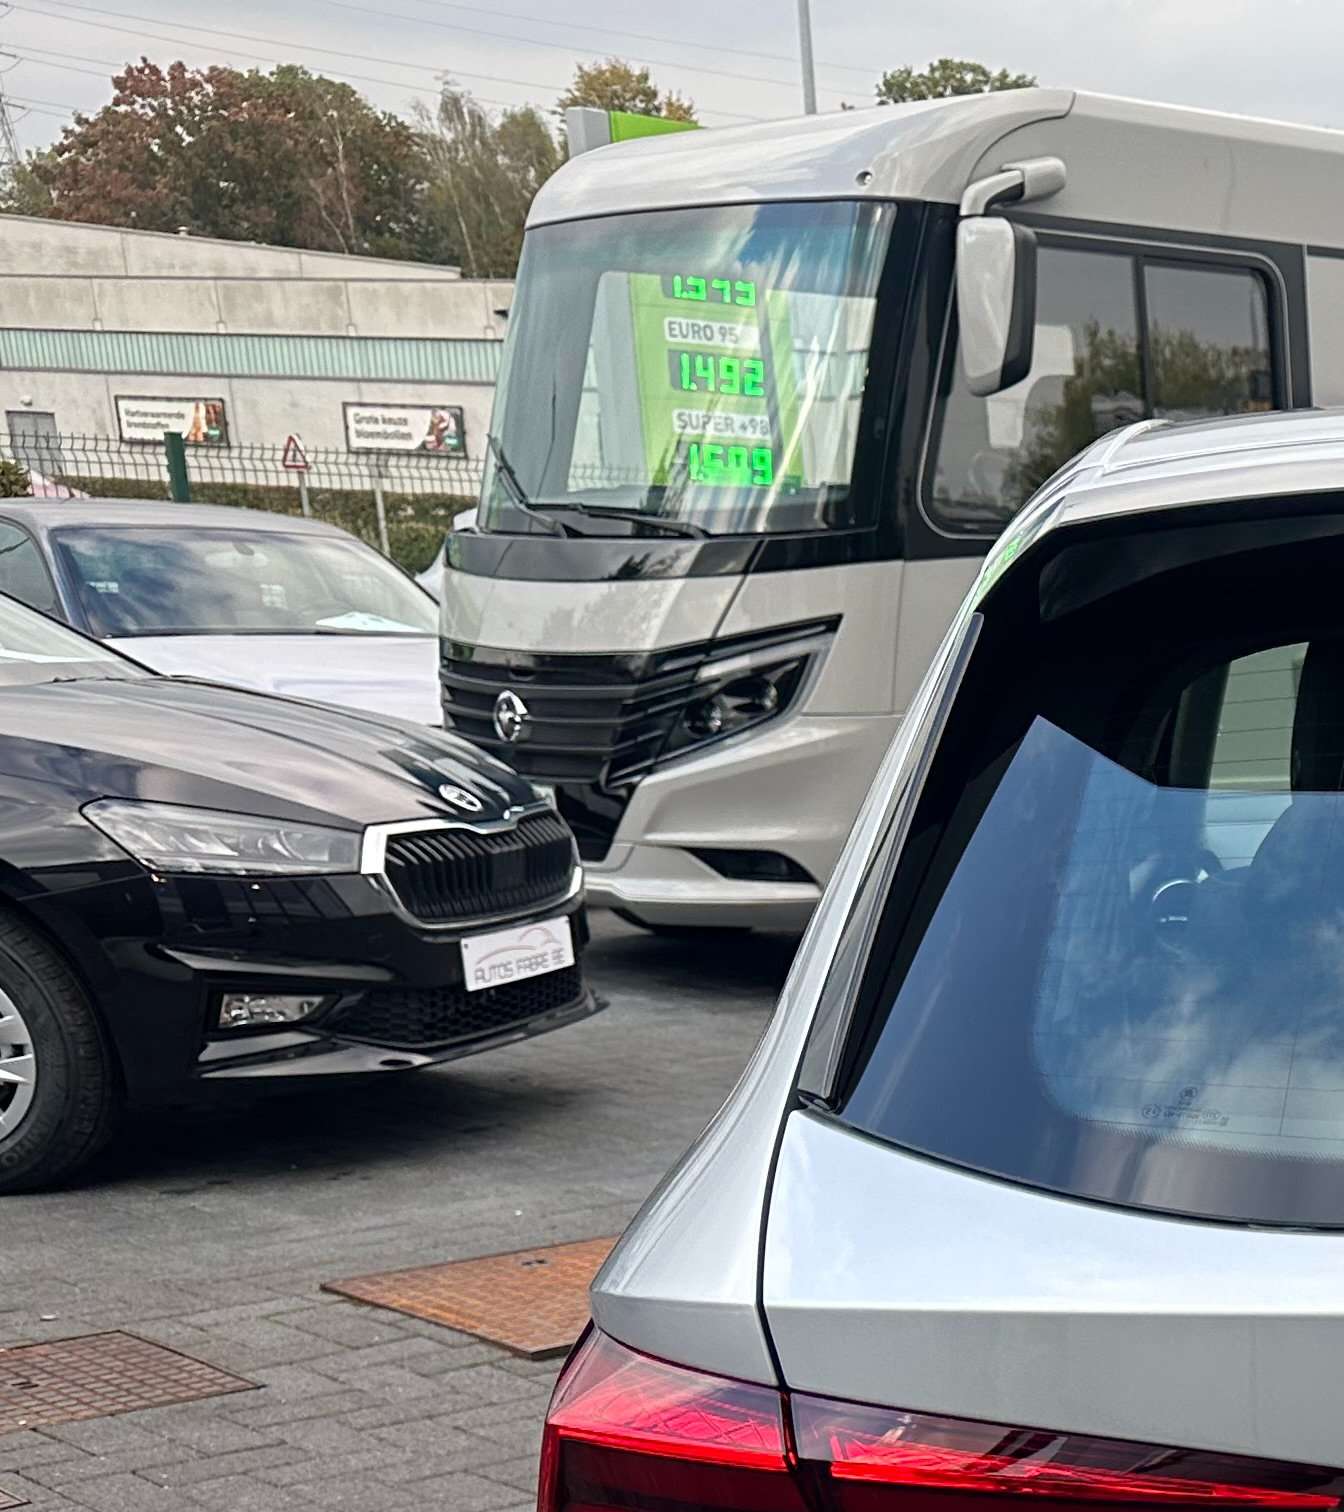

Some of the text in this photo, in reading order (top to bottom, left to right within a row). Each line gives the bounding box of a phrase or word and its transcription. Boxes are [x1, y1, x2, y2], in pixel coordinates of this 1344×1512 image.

[668, 321, 738, 344] EURO 95
[680, 353, 764, 396] 1.492
[677, 412, 734, 433] SUPER
[474, 961, 514, 985] AUTOS
